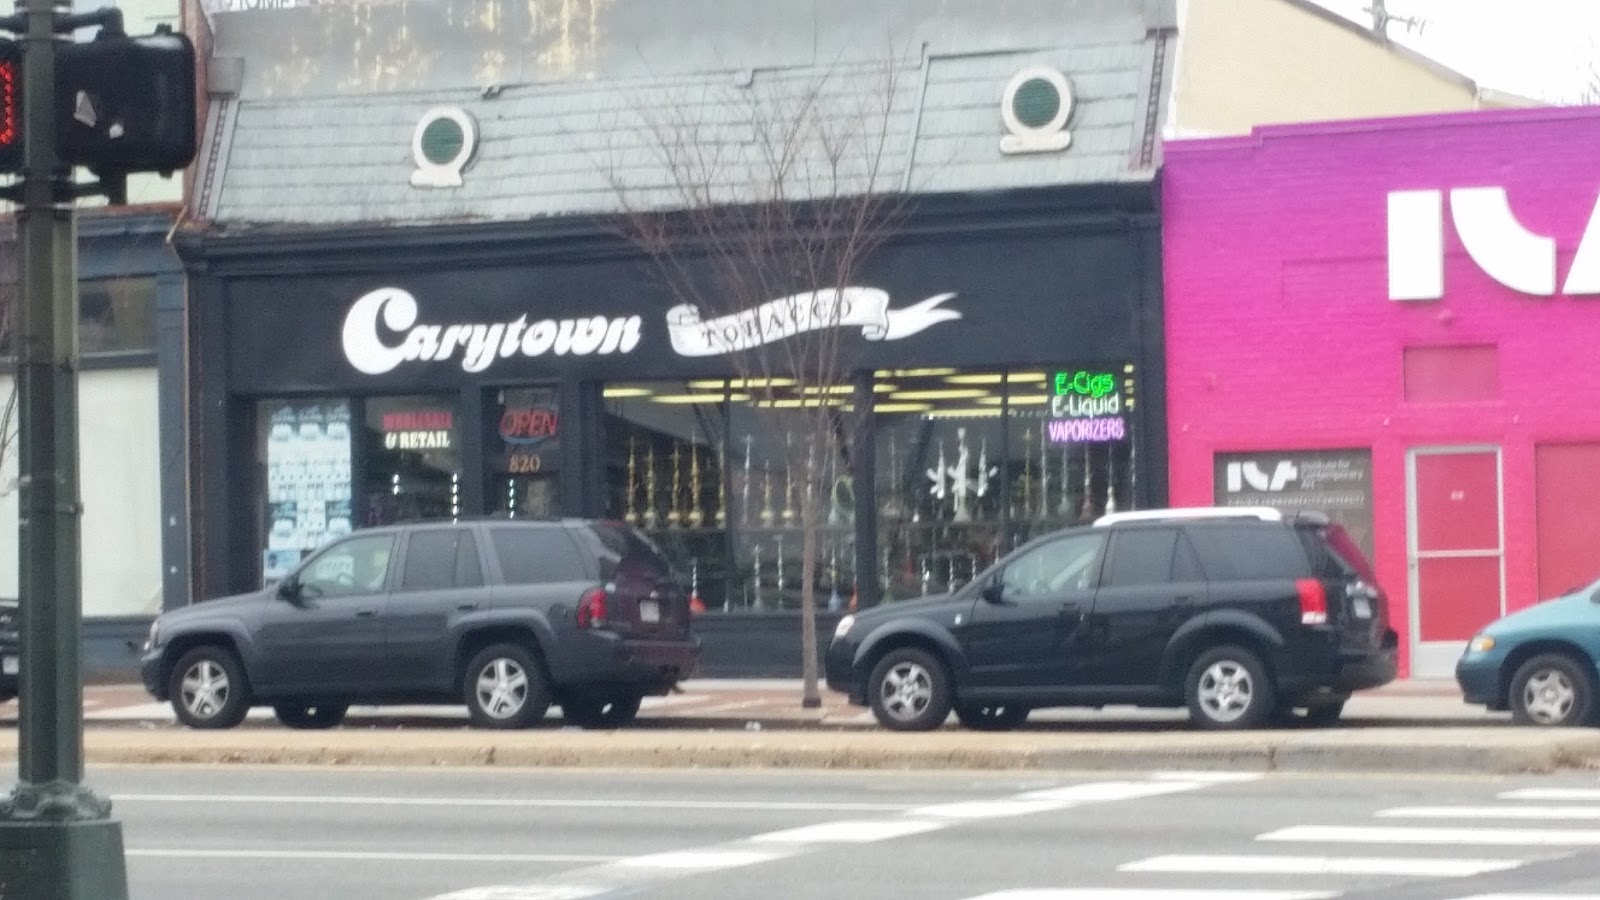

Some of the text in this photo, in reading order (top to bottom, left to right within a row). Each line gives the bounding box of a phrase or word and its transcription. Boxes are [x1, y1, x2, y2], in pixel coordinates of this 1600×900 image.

[342, 286, 642, 375] Carytown
[701, 298, 852, 348] TOBACCO
[1054, 371, 1114, 398] E-Cigs
[1052, 392, 1119, 418] E-Liquid
[500, 410, 559, 437] OPEN
[1048, 417, 1125, 442] VAPORIZERS
[399, 430, 451, 449] RETAIL
[509, 453, 541, 473] 820
